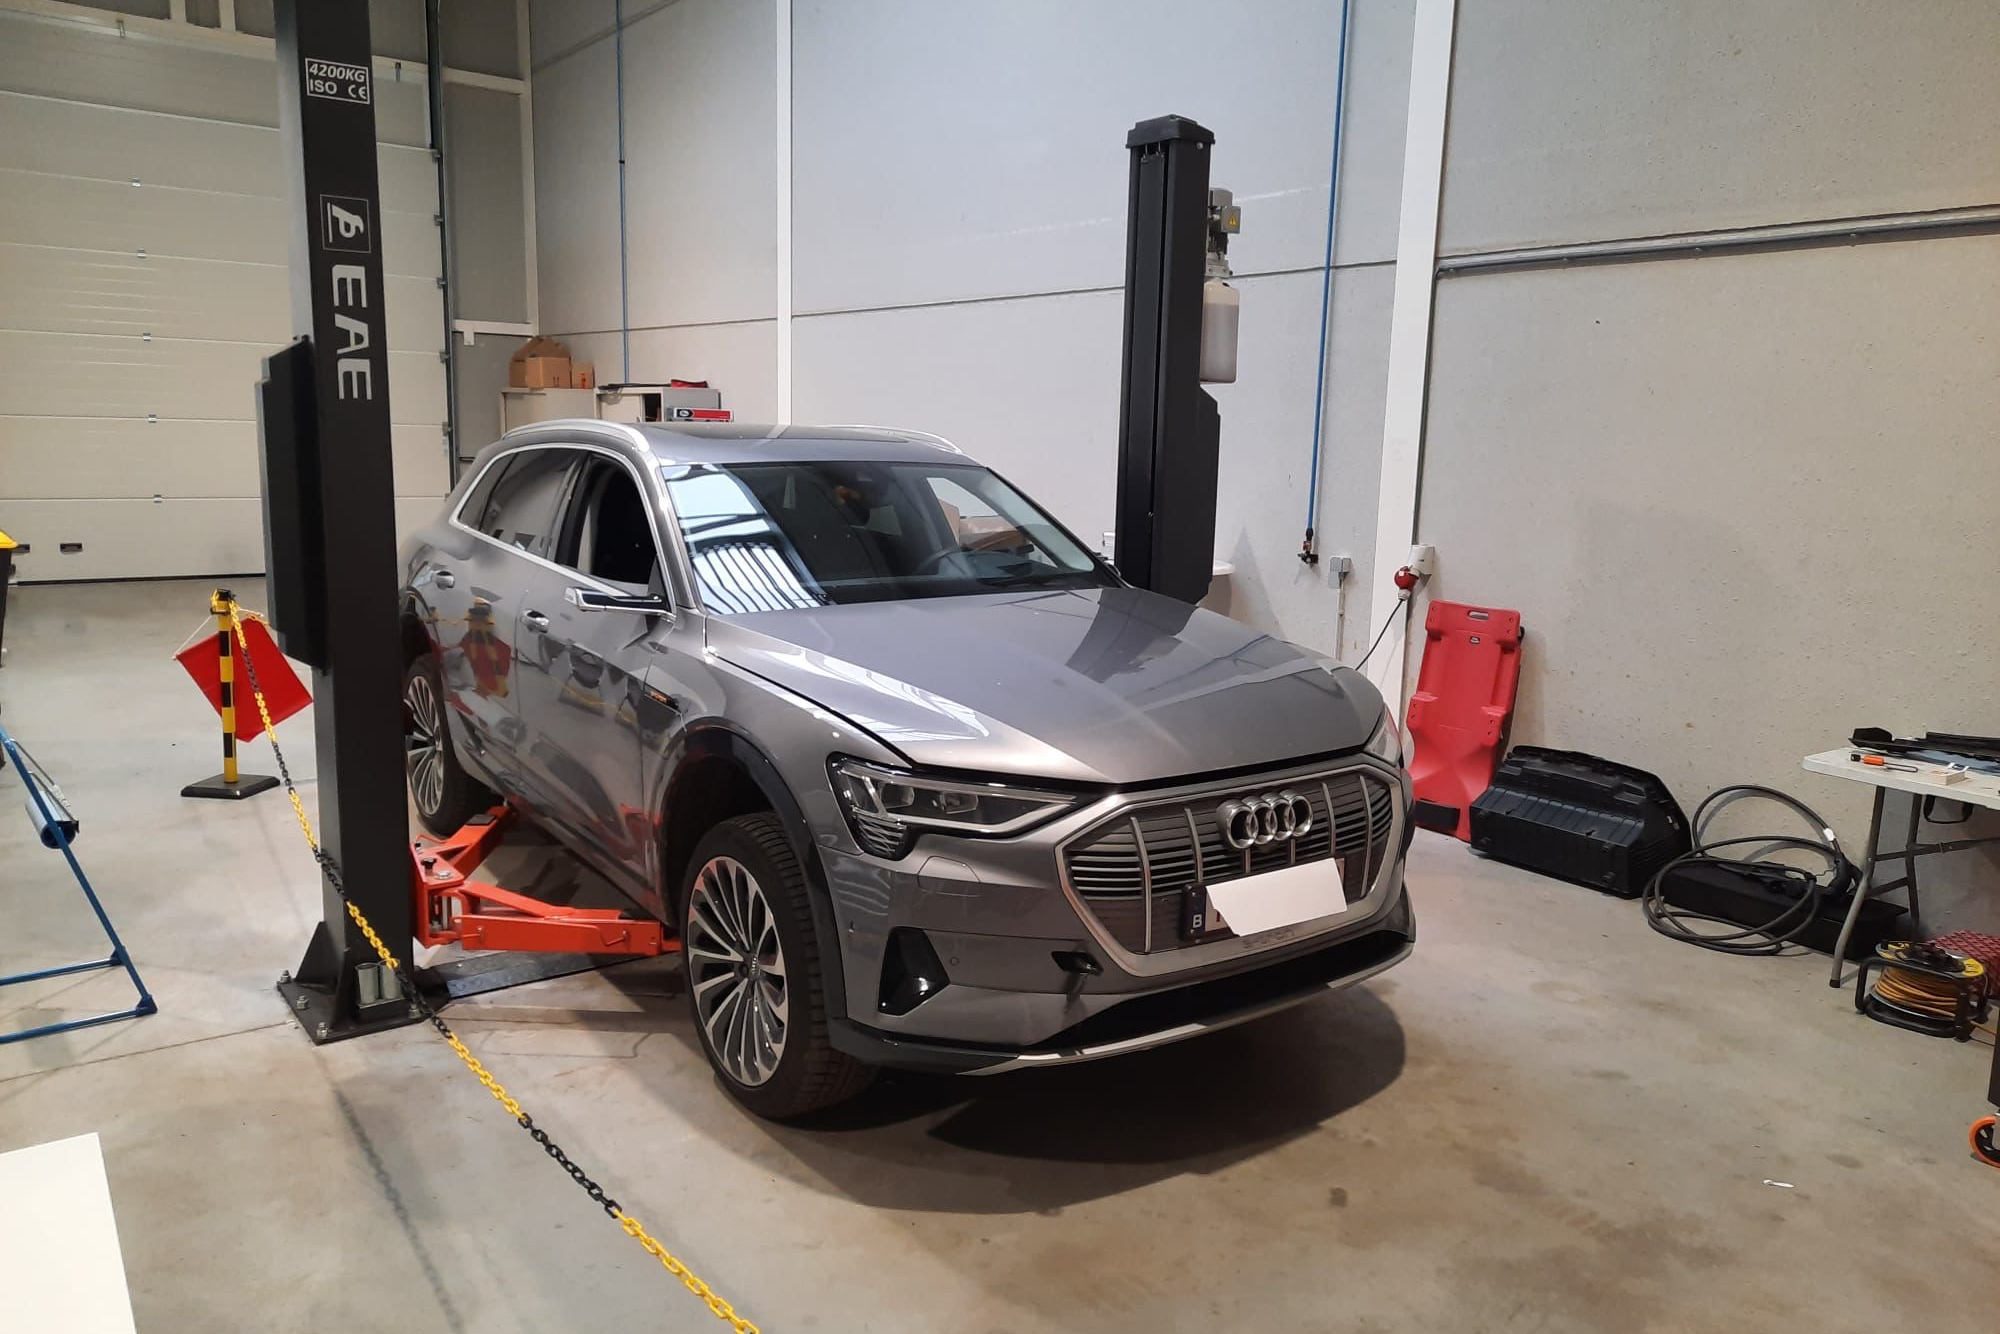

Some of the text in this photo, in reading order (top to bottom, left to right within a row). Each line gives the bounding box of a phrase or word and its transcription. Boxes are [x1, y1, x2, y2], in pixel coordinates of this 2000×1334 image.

[309, 63, 366, 82] 4200KG
[310, 79, 367, 99] ISO CE
[331, 264, 372, 400] EAE
[1192, 913, 1203, 928] B
